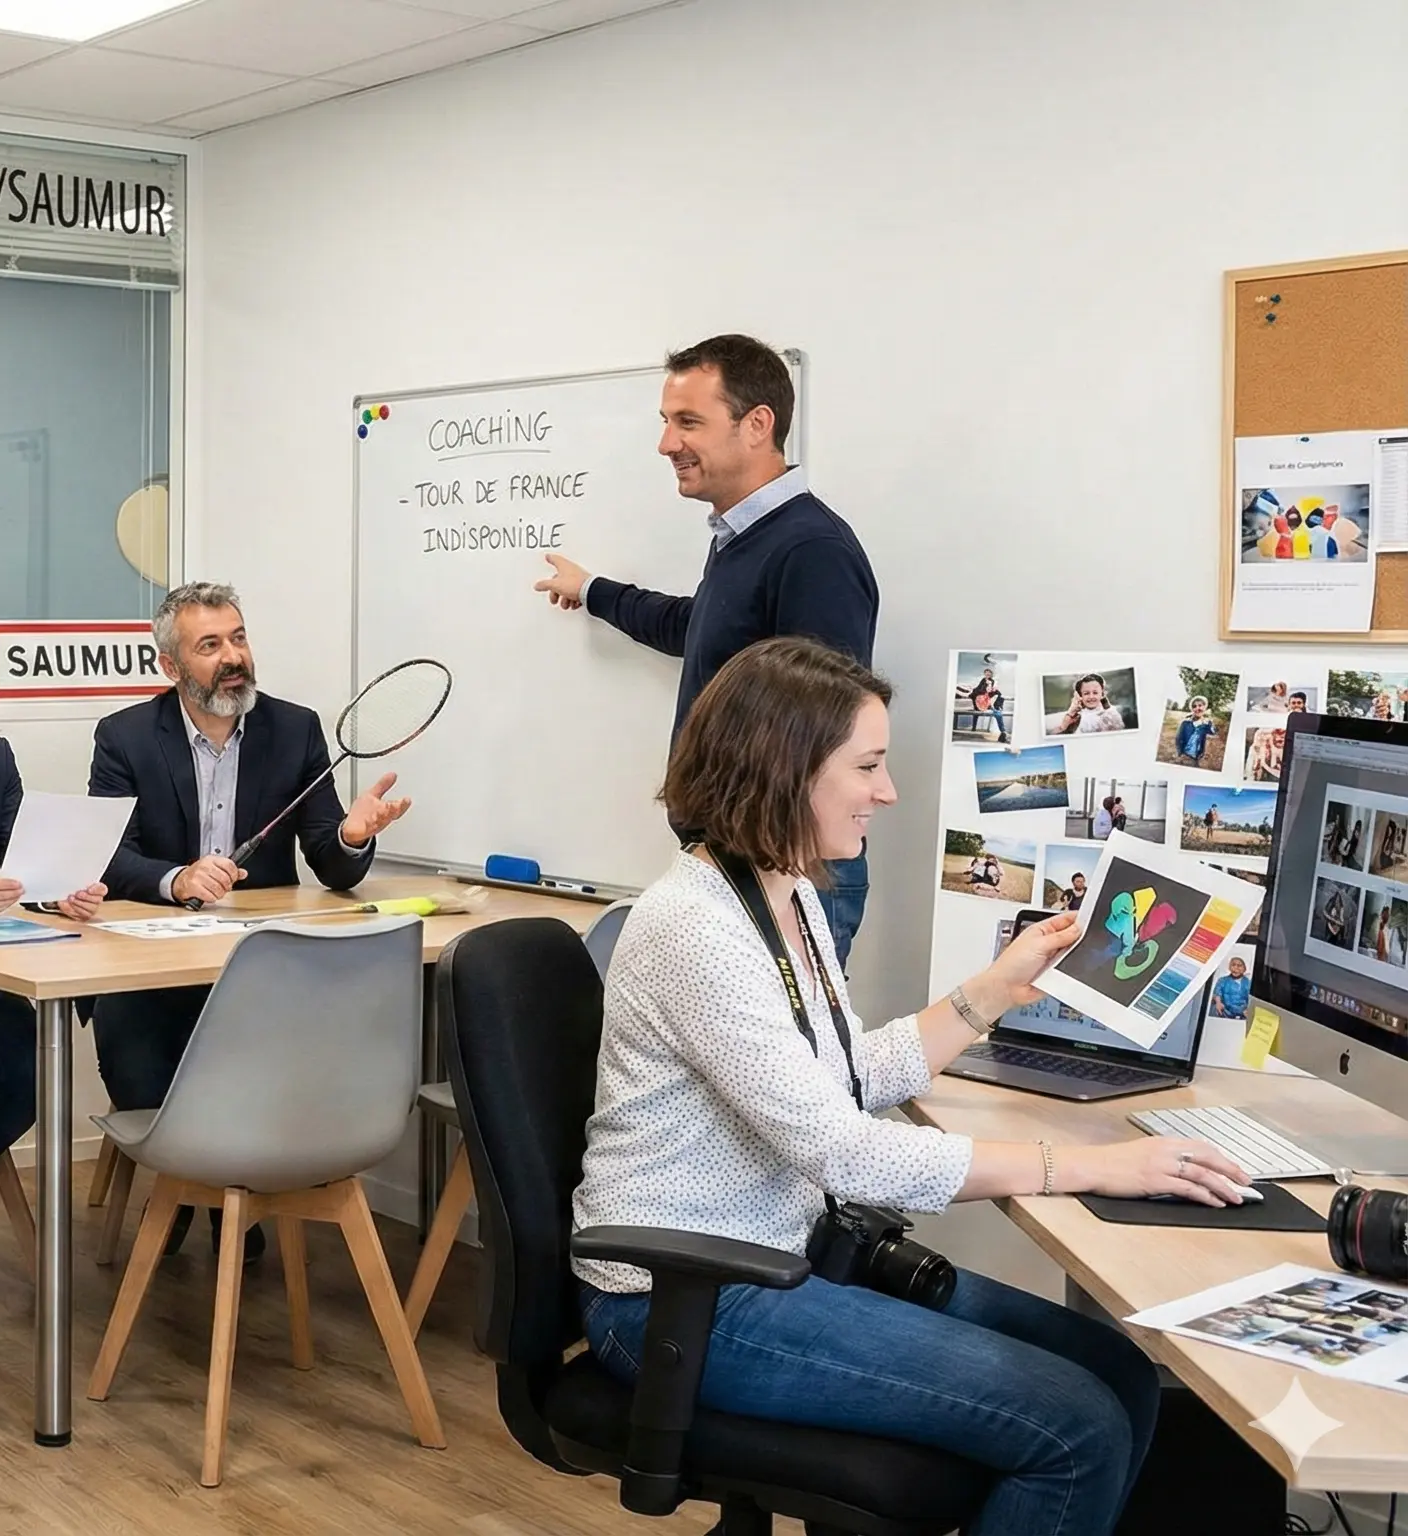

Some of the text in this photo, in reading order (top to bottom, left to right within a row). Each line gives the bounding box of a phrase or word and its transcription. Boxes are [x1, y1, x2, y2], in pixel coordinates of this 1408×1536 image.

[428, 409, 553, 451] COACHING
[415, 480, 464, 508] TOUR
[475, 480, 498, 503] DE
[509, 471, 589, 501] FRANCE
[423, 518, 566, 553] INDISPONIBLE
[7, 644, 159, 677] SAUMUR
